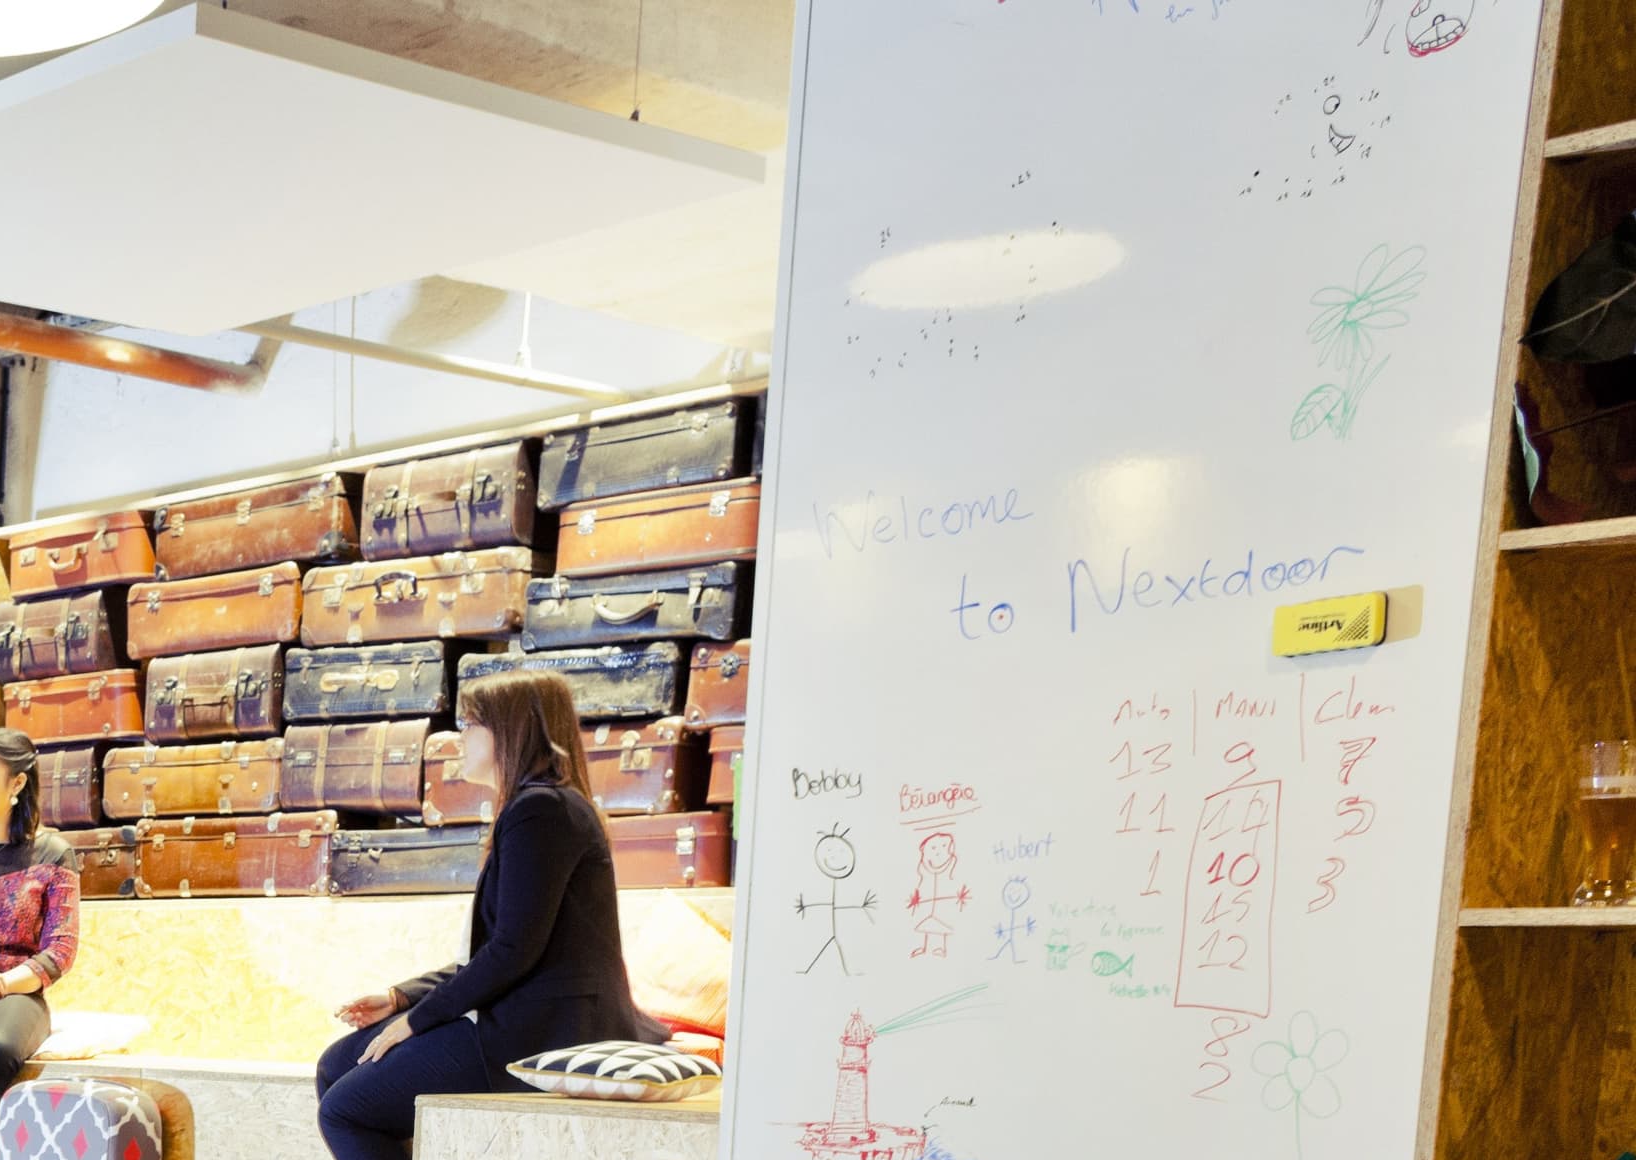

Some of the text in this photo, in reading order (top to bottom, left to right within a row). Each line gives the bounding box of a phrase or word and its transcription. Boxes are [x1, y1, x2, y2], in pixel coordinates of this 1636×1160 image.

[812, 488, 1034, 558] Welcome
[951, 546, 1365, 640] to Nextdoor
[791, 767, 862, 800] Bobby
[1109, 740, 1172, 780] 13
[1223, 741, 1257, 787] 9
[1116, 791, 1175, 833] 11
[993, 831, 1056, 865] Hubert
[1139, 850, 1346, 913] 1 10 3
[1197, 929, 1248, 971] 12
[1203, 1016, 1250, 1057] 8
[1191, 1061, 1232, 1102] 2
